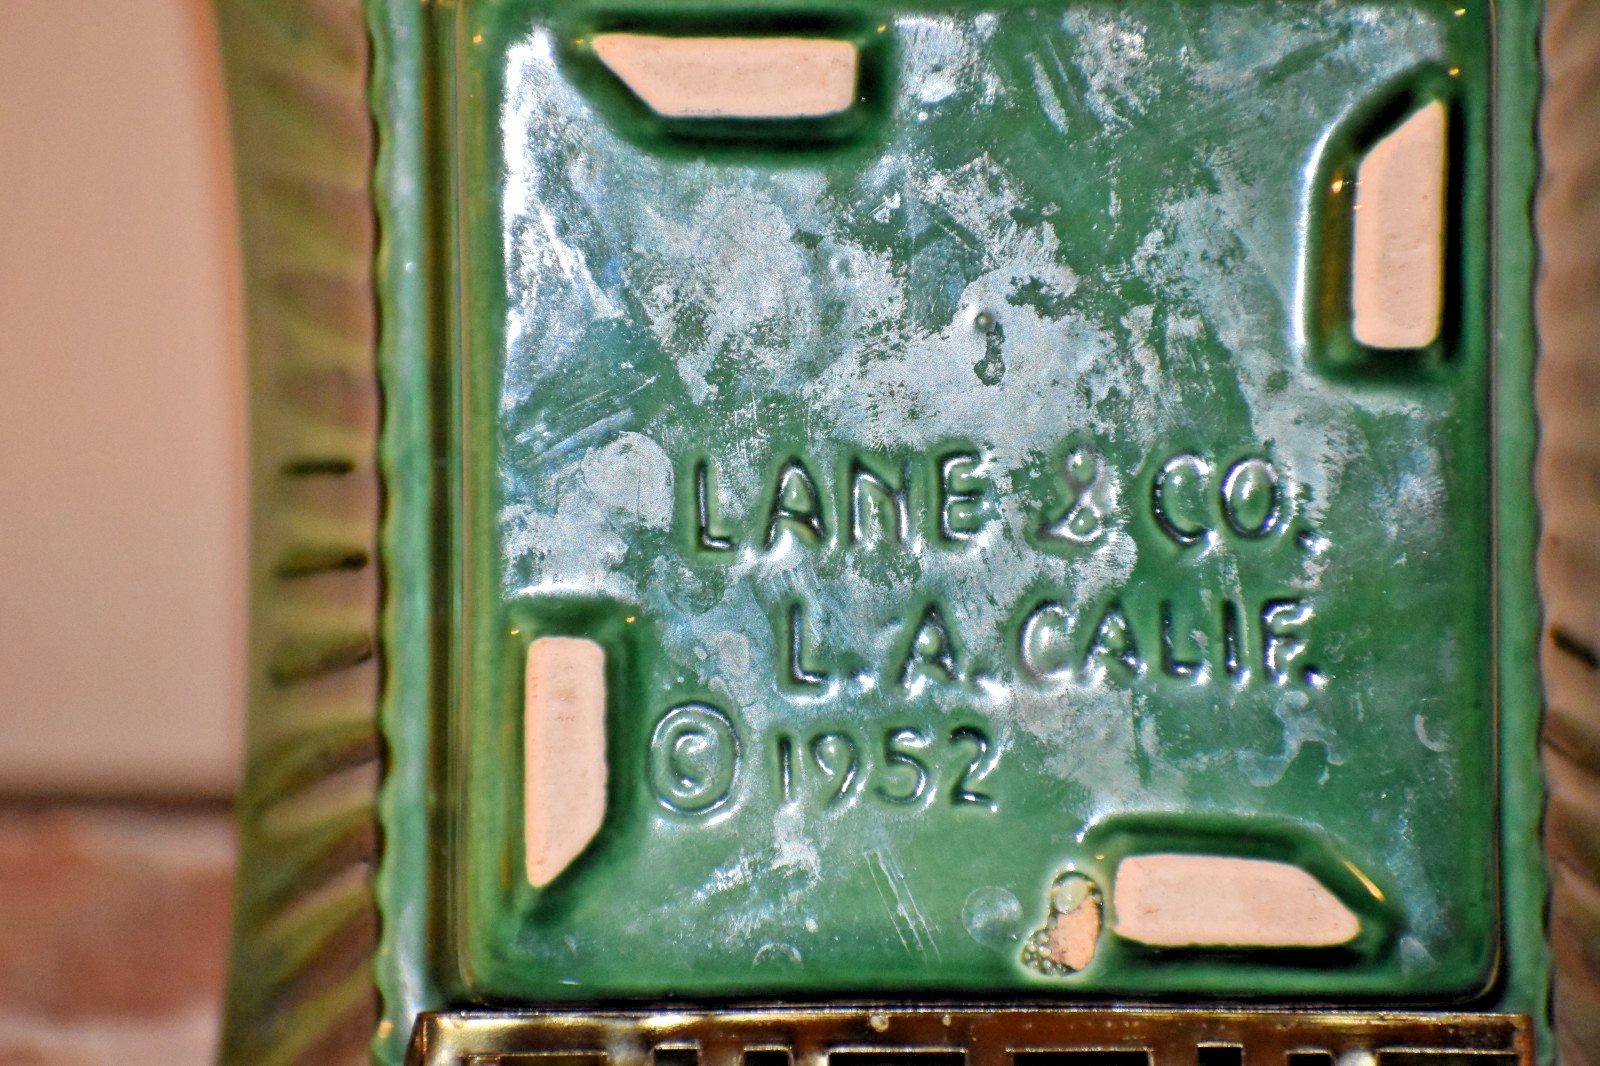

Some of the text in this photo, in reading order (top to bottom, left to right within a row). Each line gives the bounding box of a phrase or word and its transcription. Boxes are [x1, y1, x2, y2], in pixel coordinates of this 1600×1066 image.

[694, 446, 1328, 553] LANE & CO.
